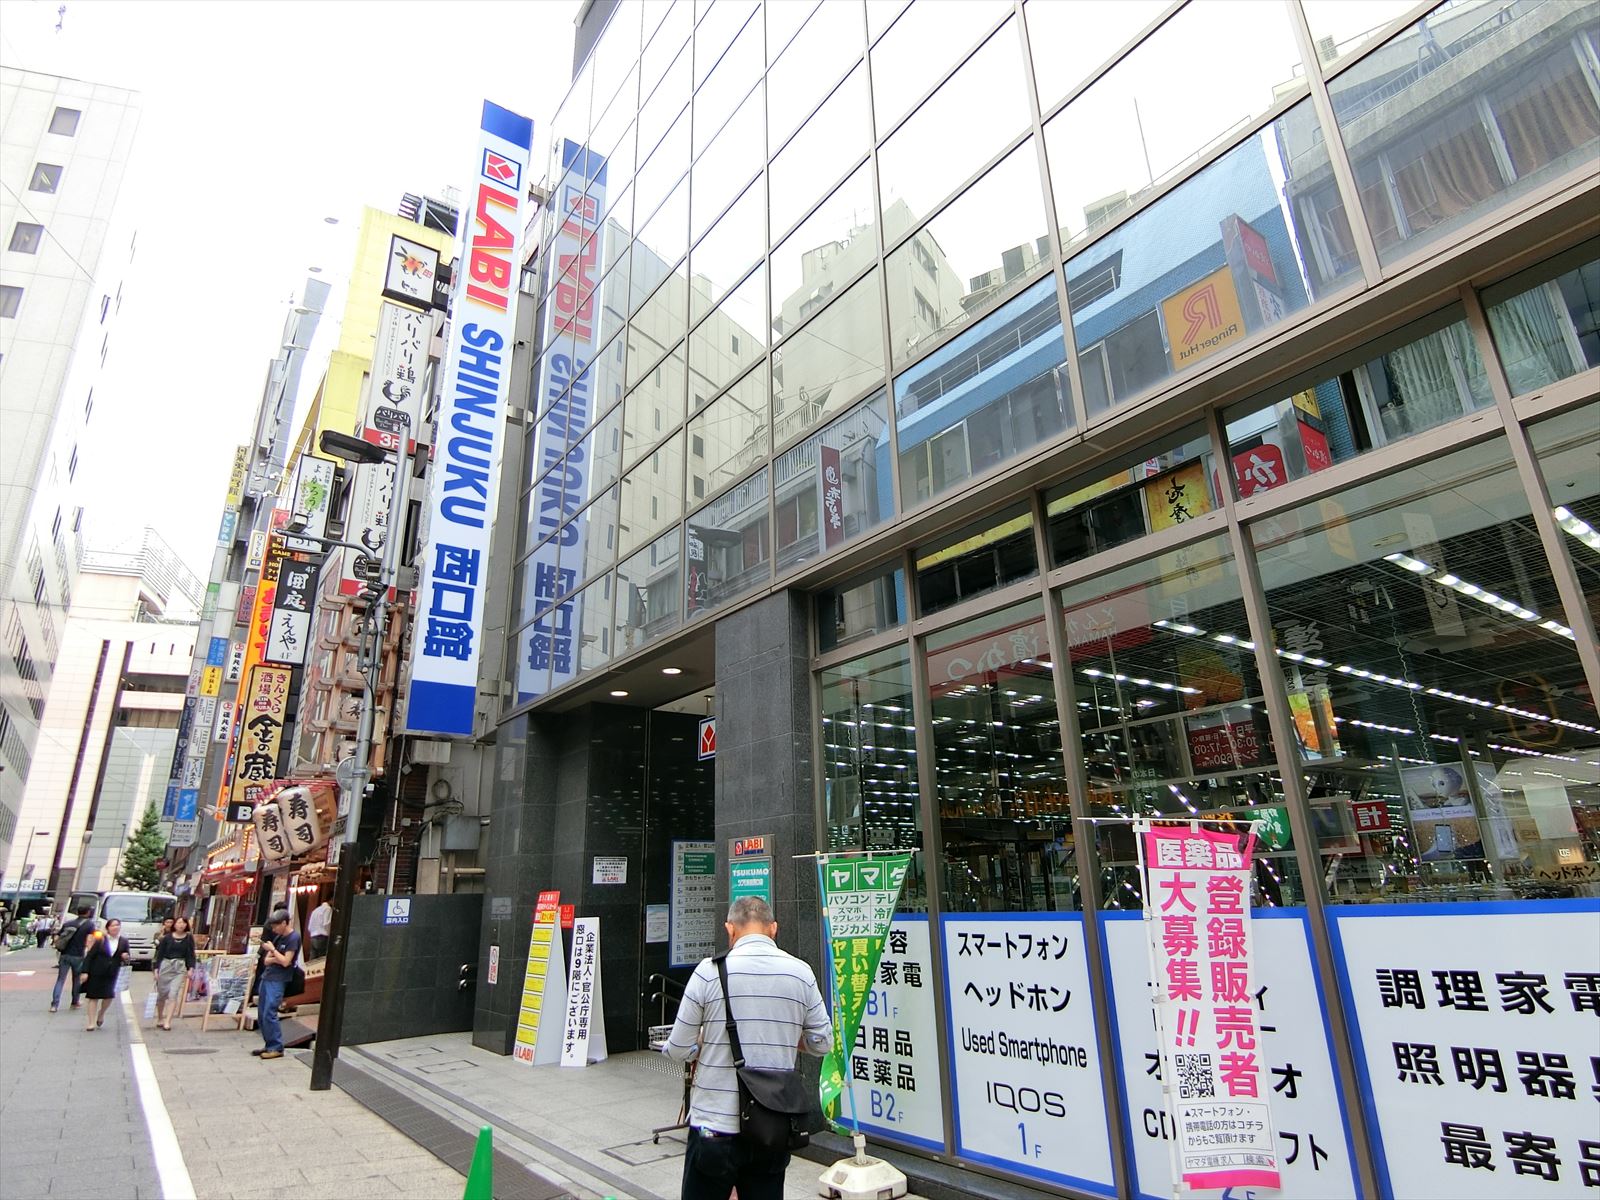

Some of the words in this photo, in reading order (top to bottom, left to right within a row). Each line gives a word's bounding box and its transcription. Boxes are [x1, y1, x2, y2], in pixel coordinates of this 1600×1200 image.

[466, 183, 519, 312] LABI
[440, 323, 504, 529] SHINJUKU
[305, 565, 317, 574] 4F
[423, 542, 481, 662] 西口館
[258, 672, 274, 695] 酒場
[271, 673, 287, 714] きんくら
[239, 714, 282, 781] 金の蔵
[261, 810, 285, 853] 寿司
[288, 793, 315, 845] 寿司
[743, 838, 764, 849] LABI
[1156, 839, 1243, 868] 医薬品
[733, 868, 769, 876] TSUKUMO
[1540, 865, 1596, 881] ヘッドホン
[832, 914, 868, 922] タブレット
[832, 923, 870, 935] デジカメ
[874, 922, 889, 935] 洗
[957, 932, 1068, 961] スマートフォン
[1159, 872, 1203, 1047] 大募集!!
[566, 924, 585, 1058] 窓口は9階にございます。
[577, 931, 595, 1040] 企業法人・官公庁専用
[873, 961, 923, 988] 家電
[1206, 875, 1259, 1099] 登録販売者
[964, 981, 1071, 1013] ヘッドホン
[519, 1046, 534, 1062] LABI
[854, 1025, 914, 1058] 日用品
[961, 1027, 995, 1056] Used
[999, 1032, 1088, 1069] Smartphone
[852, 1055, 916, 1093] 医薬品
[1391, 1041, 1600, 1104] 照明器
[987, 1081, 1066, 1118] IQOS
[1185, 1120, 1264, 1133] 携帯電話の方はコチラ
[1188, 1133, 1256, 1146] からもご覧頂けます
